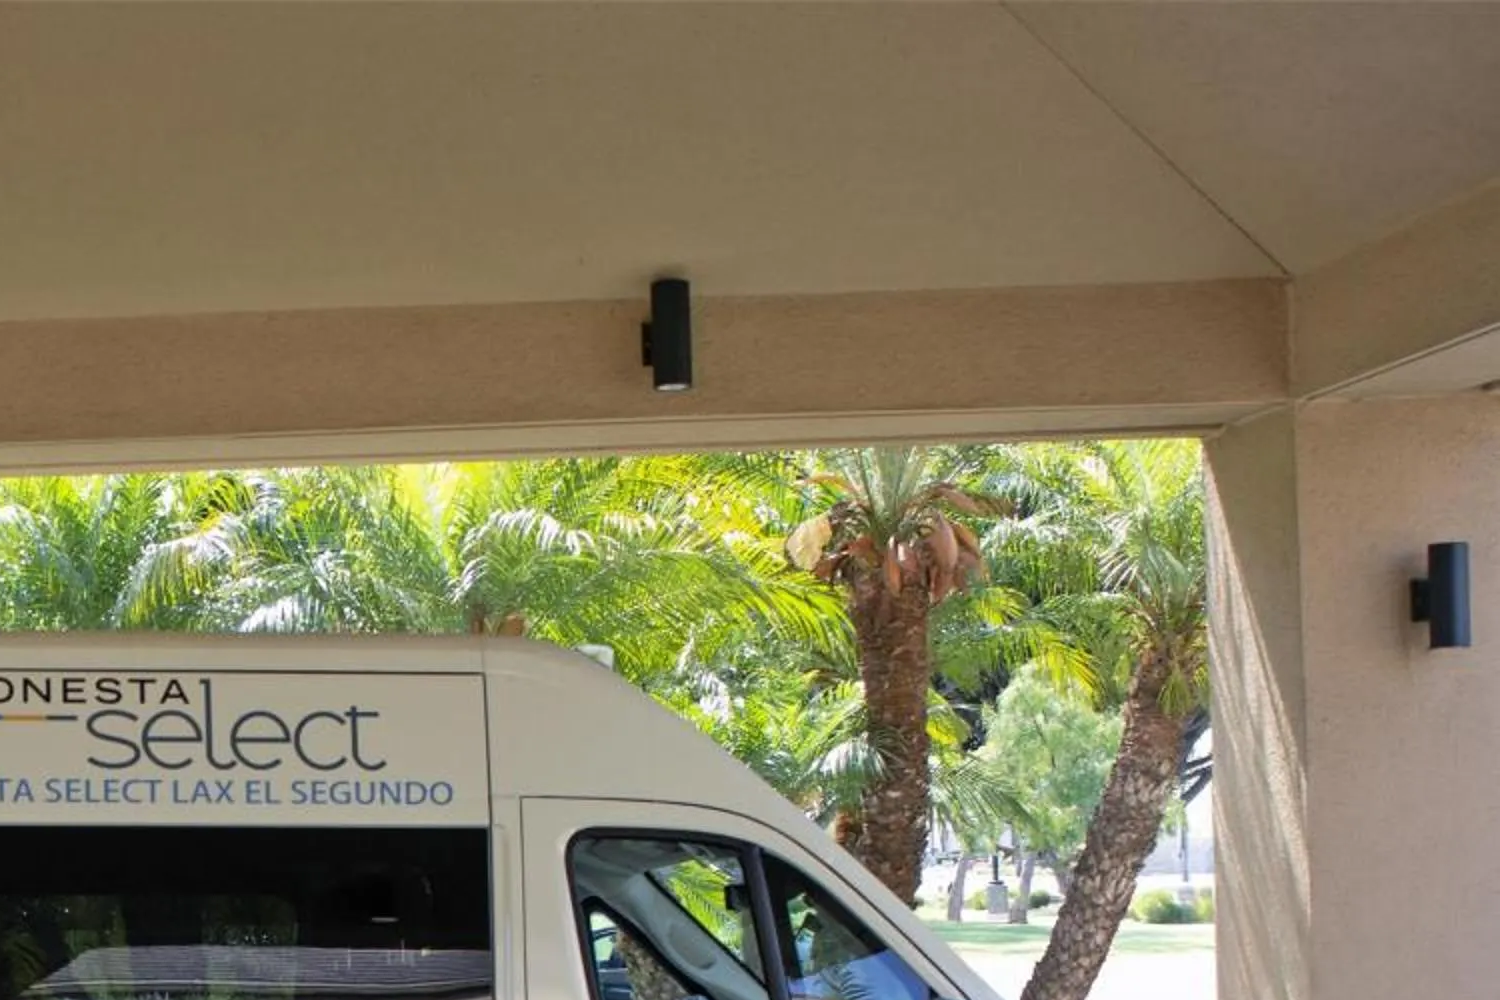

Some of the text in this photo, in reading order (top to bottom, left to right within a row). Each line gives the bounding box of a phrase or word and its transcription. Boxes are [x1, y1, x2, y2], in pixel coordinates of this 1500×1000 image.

[86, 679, 387, 771] select
[45, 778, 162, 804] SELECT
[173, 779, 234, 804] LAX
[245, 780, 281, 805] EL
[291, 780, 454, 806] SEGUNDO
